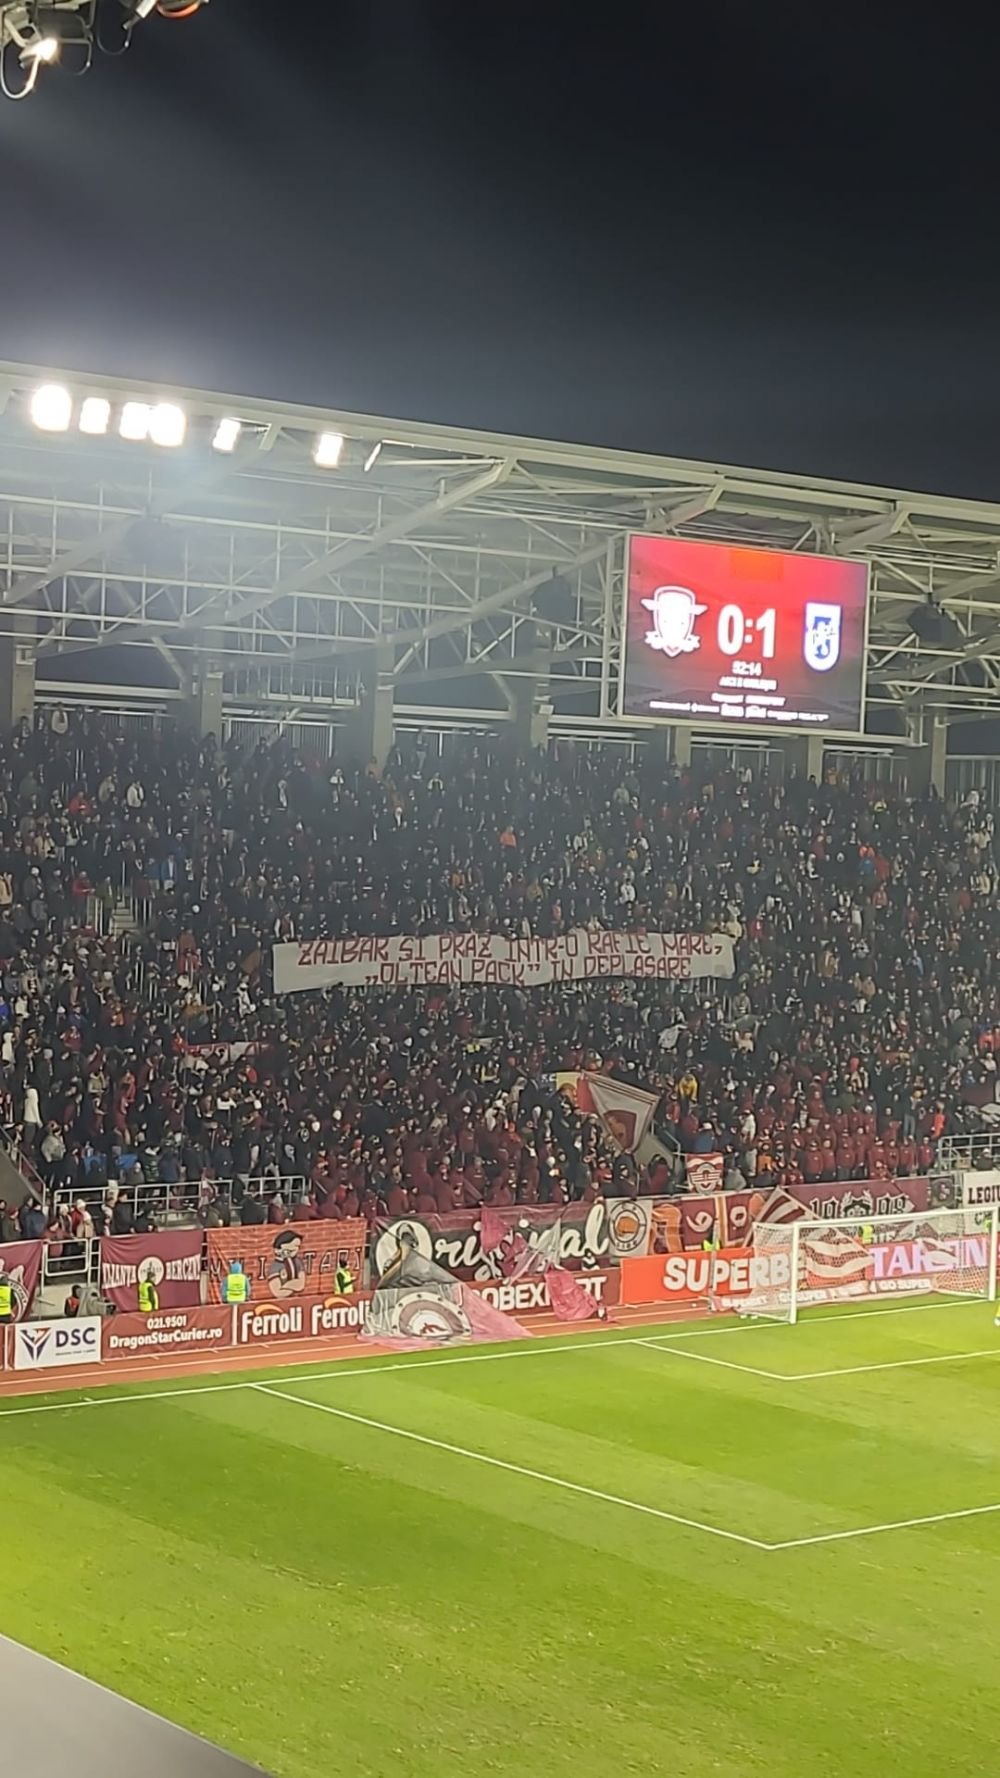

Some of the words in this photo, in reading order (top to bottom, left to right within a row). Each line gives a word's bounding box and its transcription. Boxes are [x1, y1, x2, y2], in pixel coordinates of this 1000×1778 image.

[298, 936, 390, 966] ZAIBAR
[439, 934, 493, 960] PRAZ
[583, 954, 692, 977] DEPLASARE
[241, 1306, 303, 1343] Ferroli
[311, 1300, 370, 1335] Ferroli
[55, 1327, 97, 1348] DSC
[109, 1326, 223, 1349] DragonStarCurier.ro
